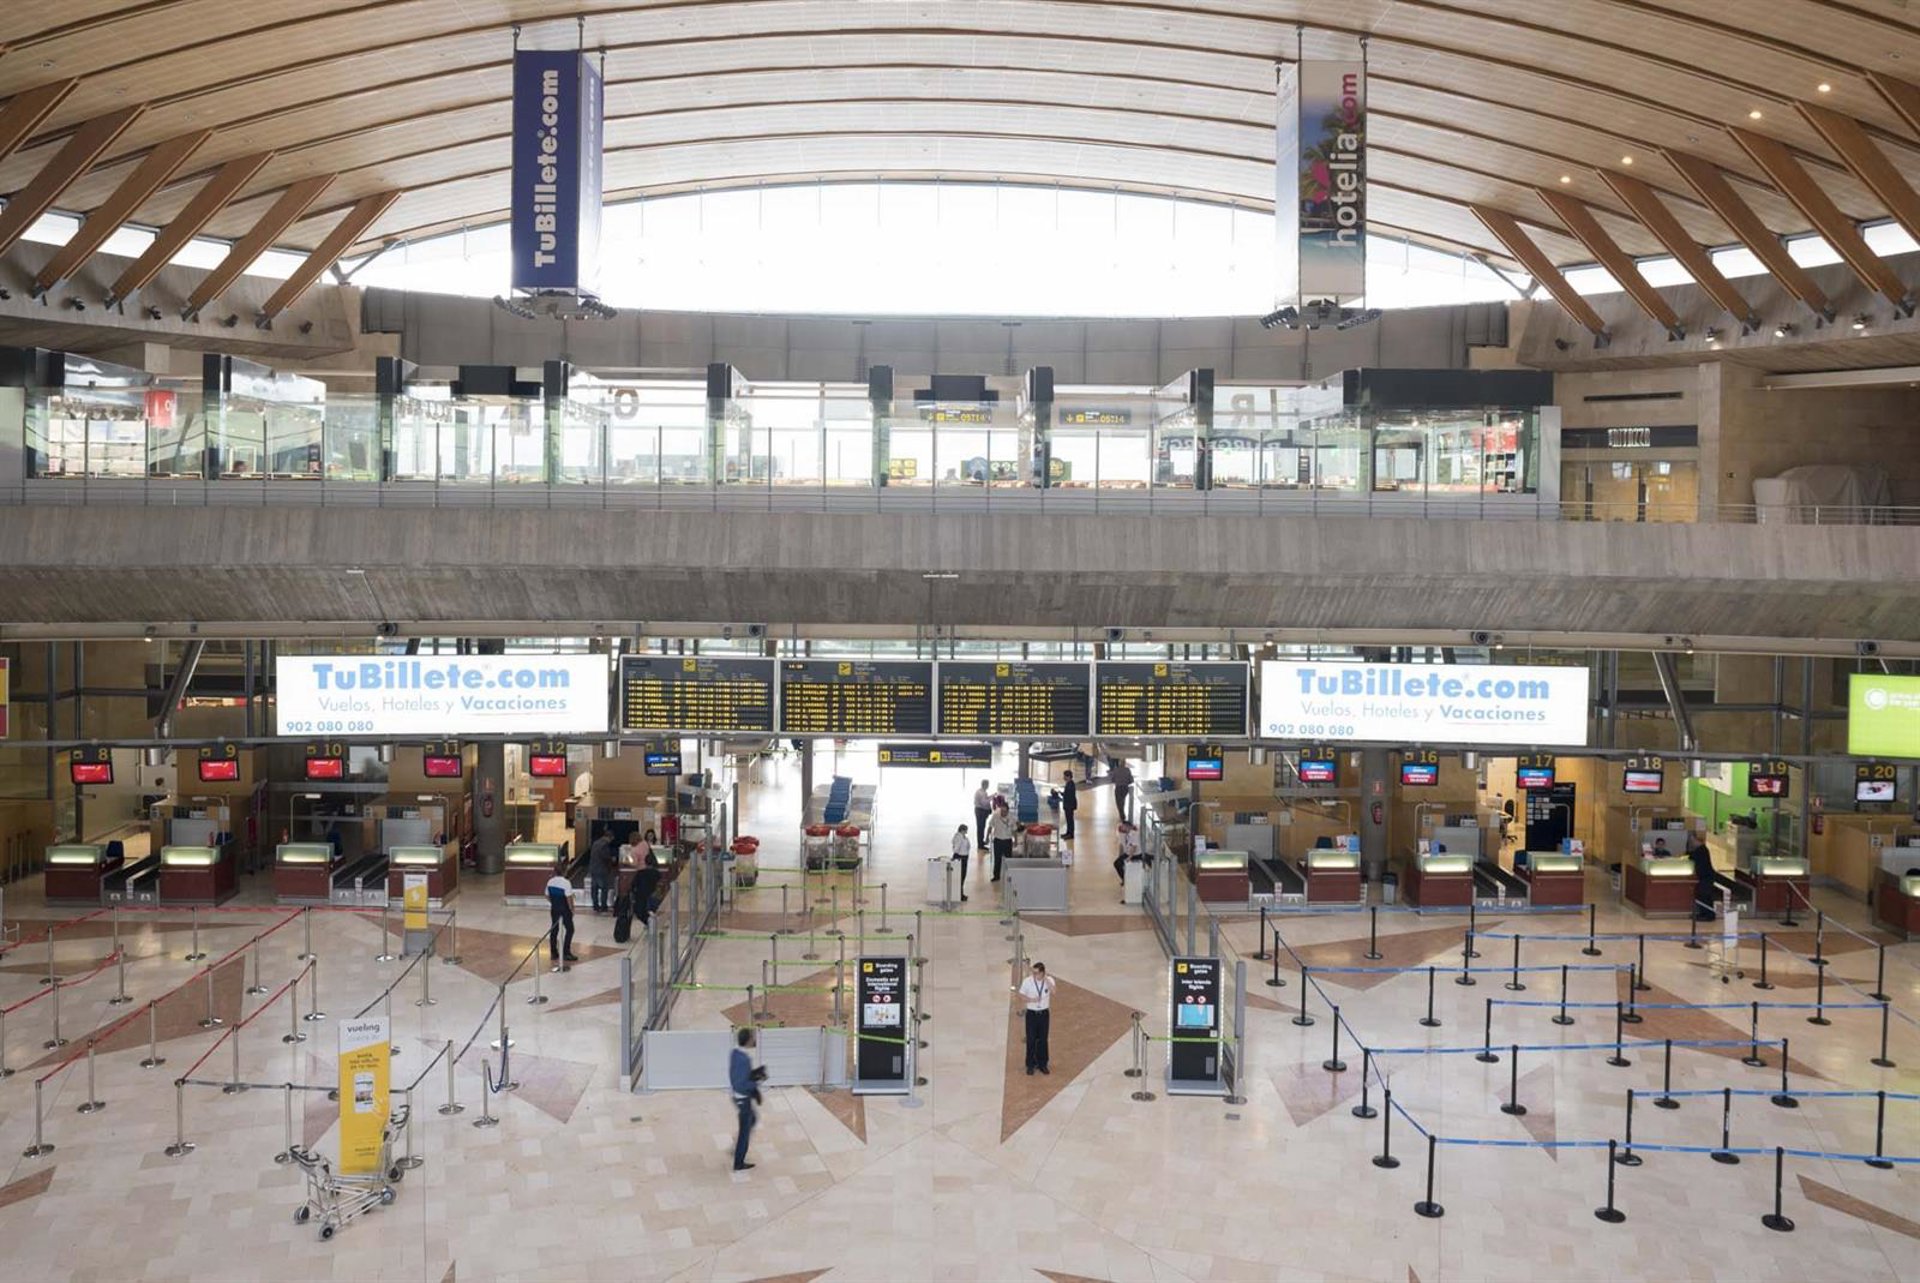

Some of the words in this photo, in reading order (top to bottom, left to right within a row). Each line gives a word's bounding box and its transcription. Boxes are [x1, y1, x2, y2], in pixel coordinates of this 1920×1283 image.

[534, 70, 558, 267] TuBillete.com
[312, 661, 570, 690] TuBillete.com
[1296, 668, 1550, 700] TuBillete.com
[318, 697, 375, 713] Vuelos,
[382, 695, 440, 712] Hoteles
[445, 700, 455, 714] y
[460, 694, 567, 711] Vacaciones
[1300, 700, 1356, 718] Vuelos,
[1362, 703, 1419, 720] Hoteles
[1424, 709, 1434, 723] y
[1439, 704, 1546, 721] Vacaciones
[286, 721, 312, 732] 902
[317, 721, 343, 731] 080
[348, 720, 374, 731] 080
[1269, 723, 1295, 734] 902
[1299, 724, 1325, 735] 080
[1329, 725, 1354, 736] 080
[226, 745, 236, 757] 9
[324, 743, 342, 756] 10
[442, 743, 460, 755] 11
[548, 741, 566, 754] 12
[663, 740, 679, 752] 13
[1206, 745, 1223, 757] 14
[98, 749, 108, 760] 8
[1317, 747, 1335, 760] 15
[1420, 750, 1437, 763] 16
[1536, 754, 1553, 767] 17
[1643, 757, 1662, 769] 18
[1768, 761, 1786, 774] 19
[1874, 766, 1895, 778] 20
[347, 1023, 380, 1034] vueling
